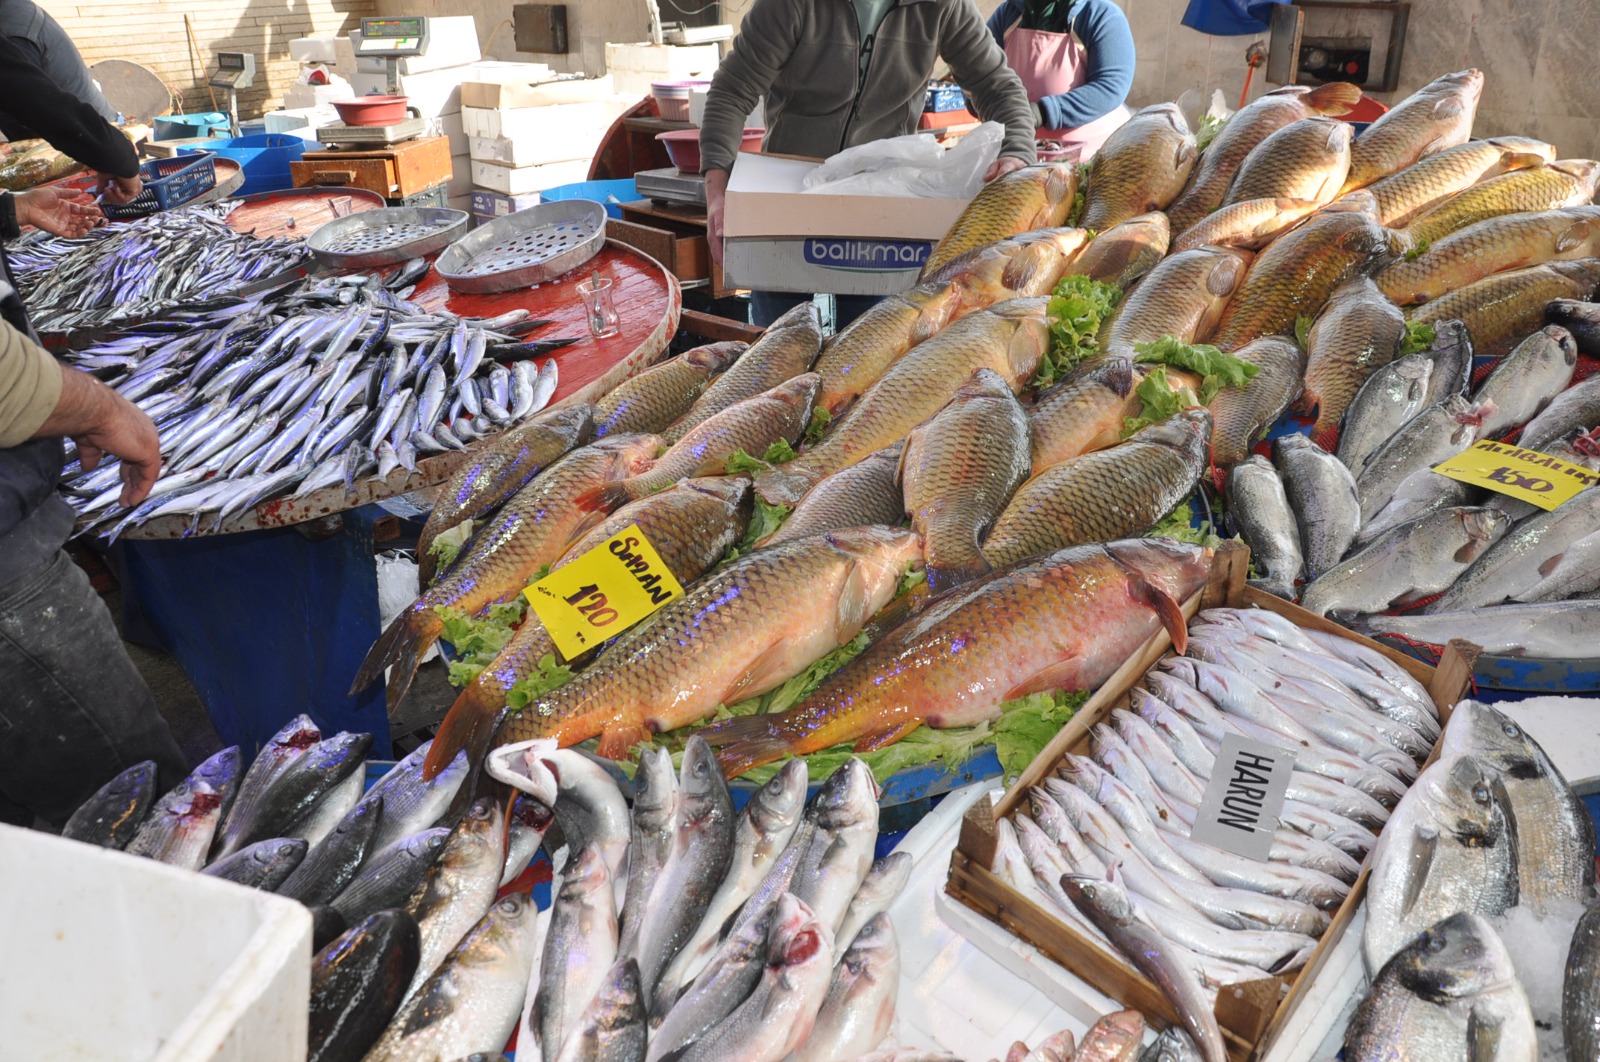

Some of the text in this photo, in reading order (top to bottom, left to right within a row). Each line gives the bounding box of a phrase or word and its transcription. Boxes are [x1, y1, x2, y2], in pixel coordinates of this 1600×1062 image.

[1481, 467, 1554, 492] 150
[608, 536, 673, 606] SAZAN
[563, 583, 619, 627] 120
[1216, 750, 1275, 833] HARUN
